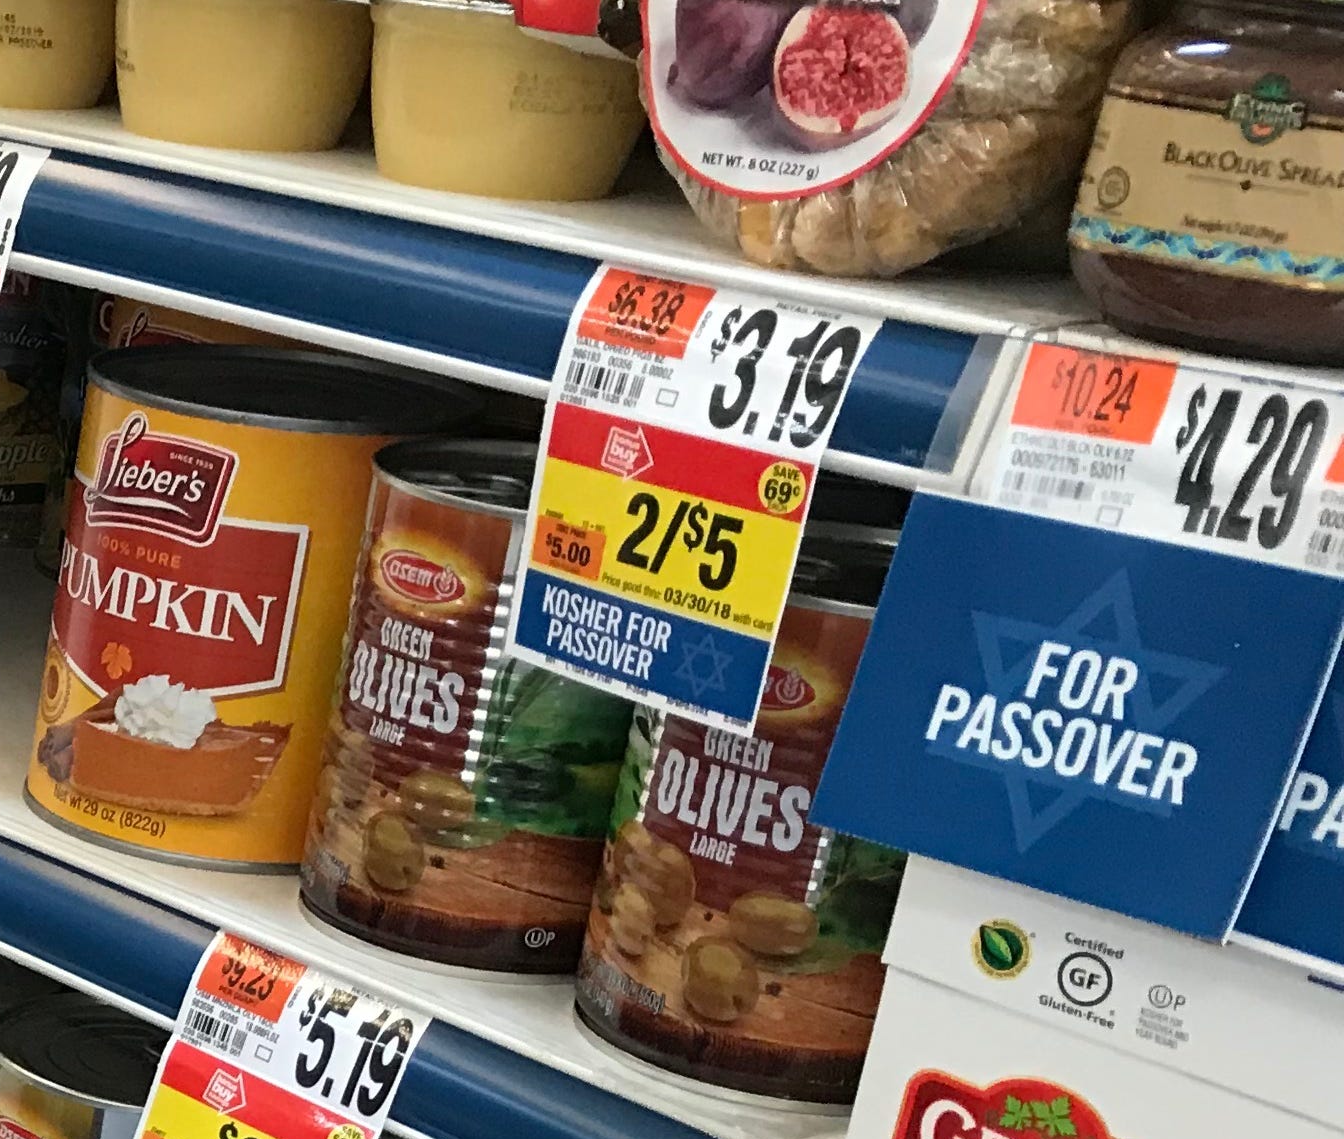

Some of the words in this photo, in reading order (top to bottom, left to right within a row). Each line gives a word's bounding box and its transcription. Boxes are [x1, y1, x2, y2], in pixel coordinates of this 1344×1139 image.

[701, 152, 723, 167] NET
[724, 154, 746, 170] WT.
[758, 159, 777, 173] OZ
[778, 160, 805, 177] (227
[607, 281, 684, 336] $6.38
[708, 304, 862, 449] $3.19
[1052, 362, 1138, 422] $10.24
[98, 411, 207, 504] Lieber's
[772, 464, 800, 481] SAVE
[1174, 383, 1330, 550] $4.29
[135, 547, 182, 570] PURE
[546, 532, 591, 568] $5.00
[617, 492, 745, 592] 2/$5
[61, 539, 279, 647] PUMPKIN
[542, 584, 622, 638] KOSHER
[625, 612, 671, 653] FOR
[664, 587, 731, 621] 03/30/18
[381, 616, 434, 661] GREEN
[547, 619, 654, 681] PASSOVER
[349, 640, 467, 735] OLIVES
[1024, 640, 1139, 720] FOR
[369, 717, 406, 747] LARGE
[703, 727, 774, 772] GREEN
[925, 684, 1199, 806] PASSOVER
[67, 792, 82, 808] wt
[83, 797, 99, 816] 29
[101, 806, 116, 824] oz
[119, 809, 167, 839] (822g)
[657, 749, 811, 853] OLIVES
[689, 832, 737, 868] LARGE
[1064, 930, 1125, 961] Certified
[1068, 967, 1102, 991] GF
[1038, 993, 1116, 1030] Gluten-Free
[295, 986, 415, 1118] $5.19
